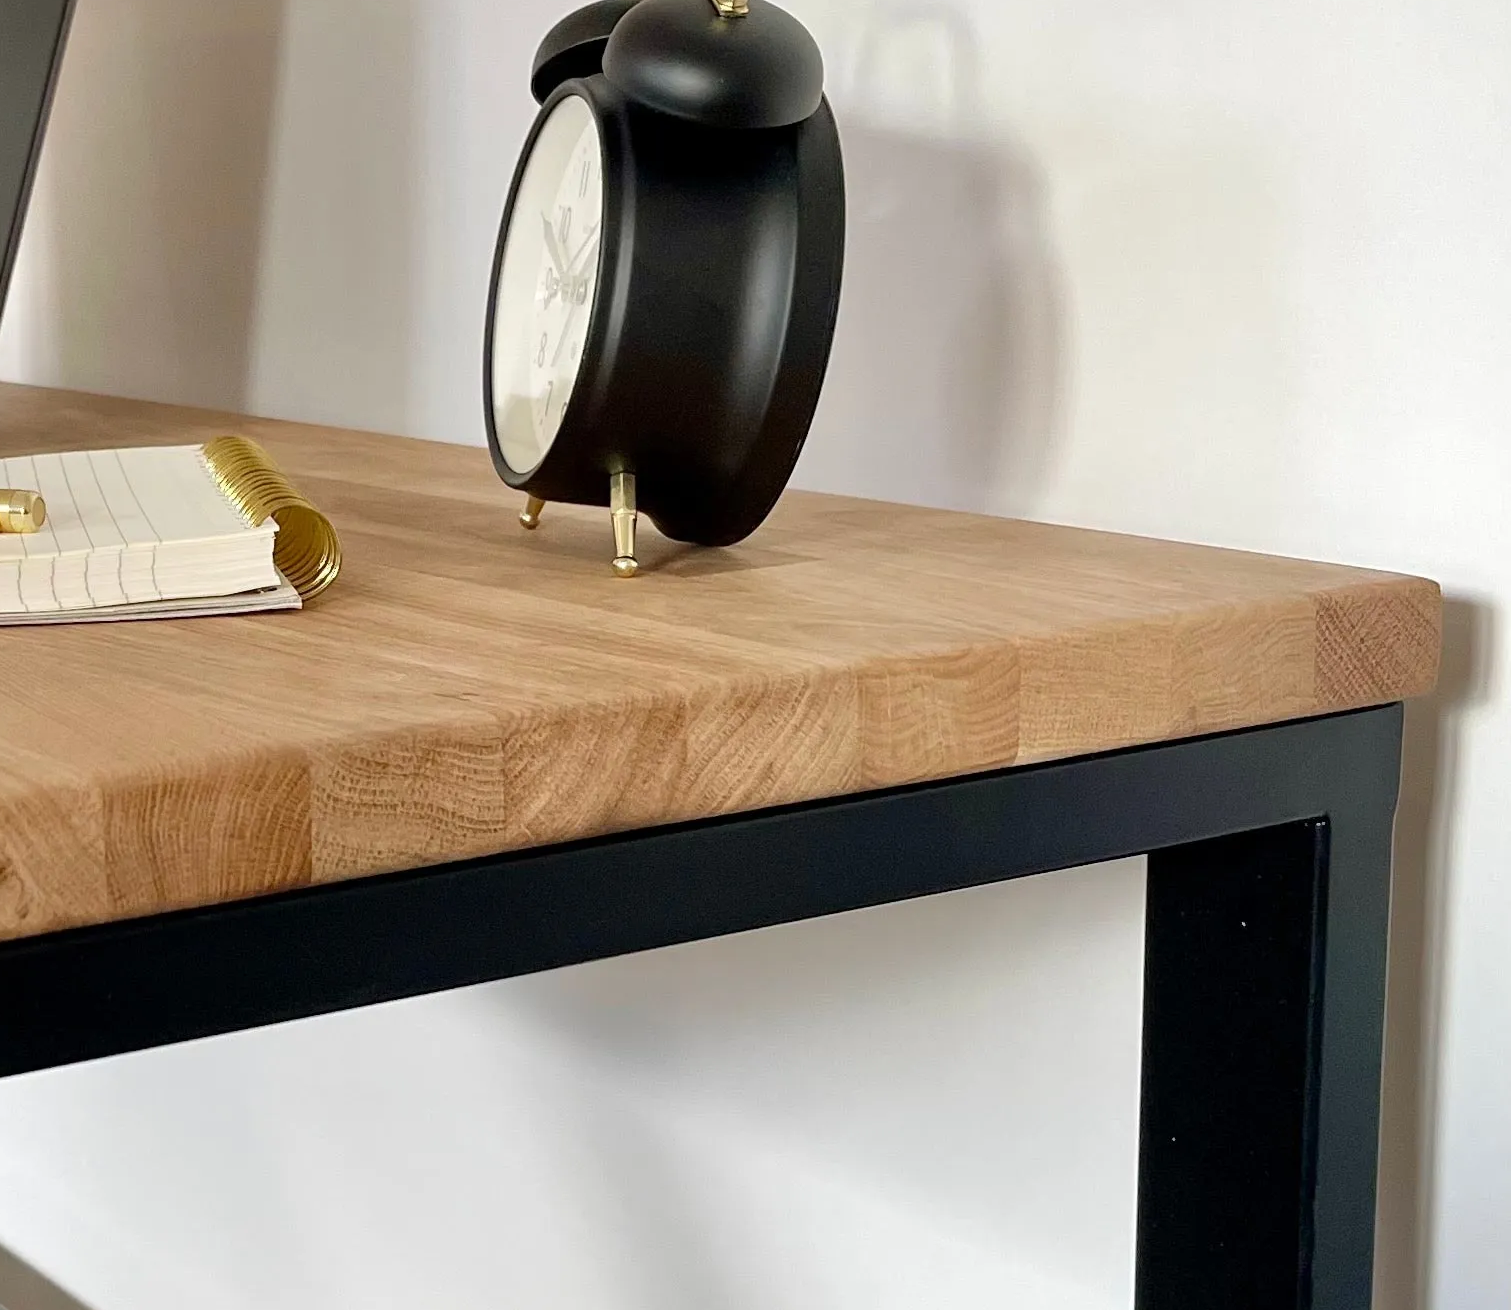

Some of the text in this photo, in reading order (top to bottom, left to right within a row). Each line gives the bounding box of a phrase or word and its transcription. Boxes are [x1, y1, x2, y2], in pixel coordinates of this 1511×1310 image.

[578, 160, 592, 199] 11
[558, 204, 572, 243] 10
[538, 332, 548, 368] 8
[544, 380, 554, 417] 7
